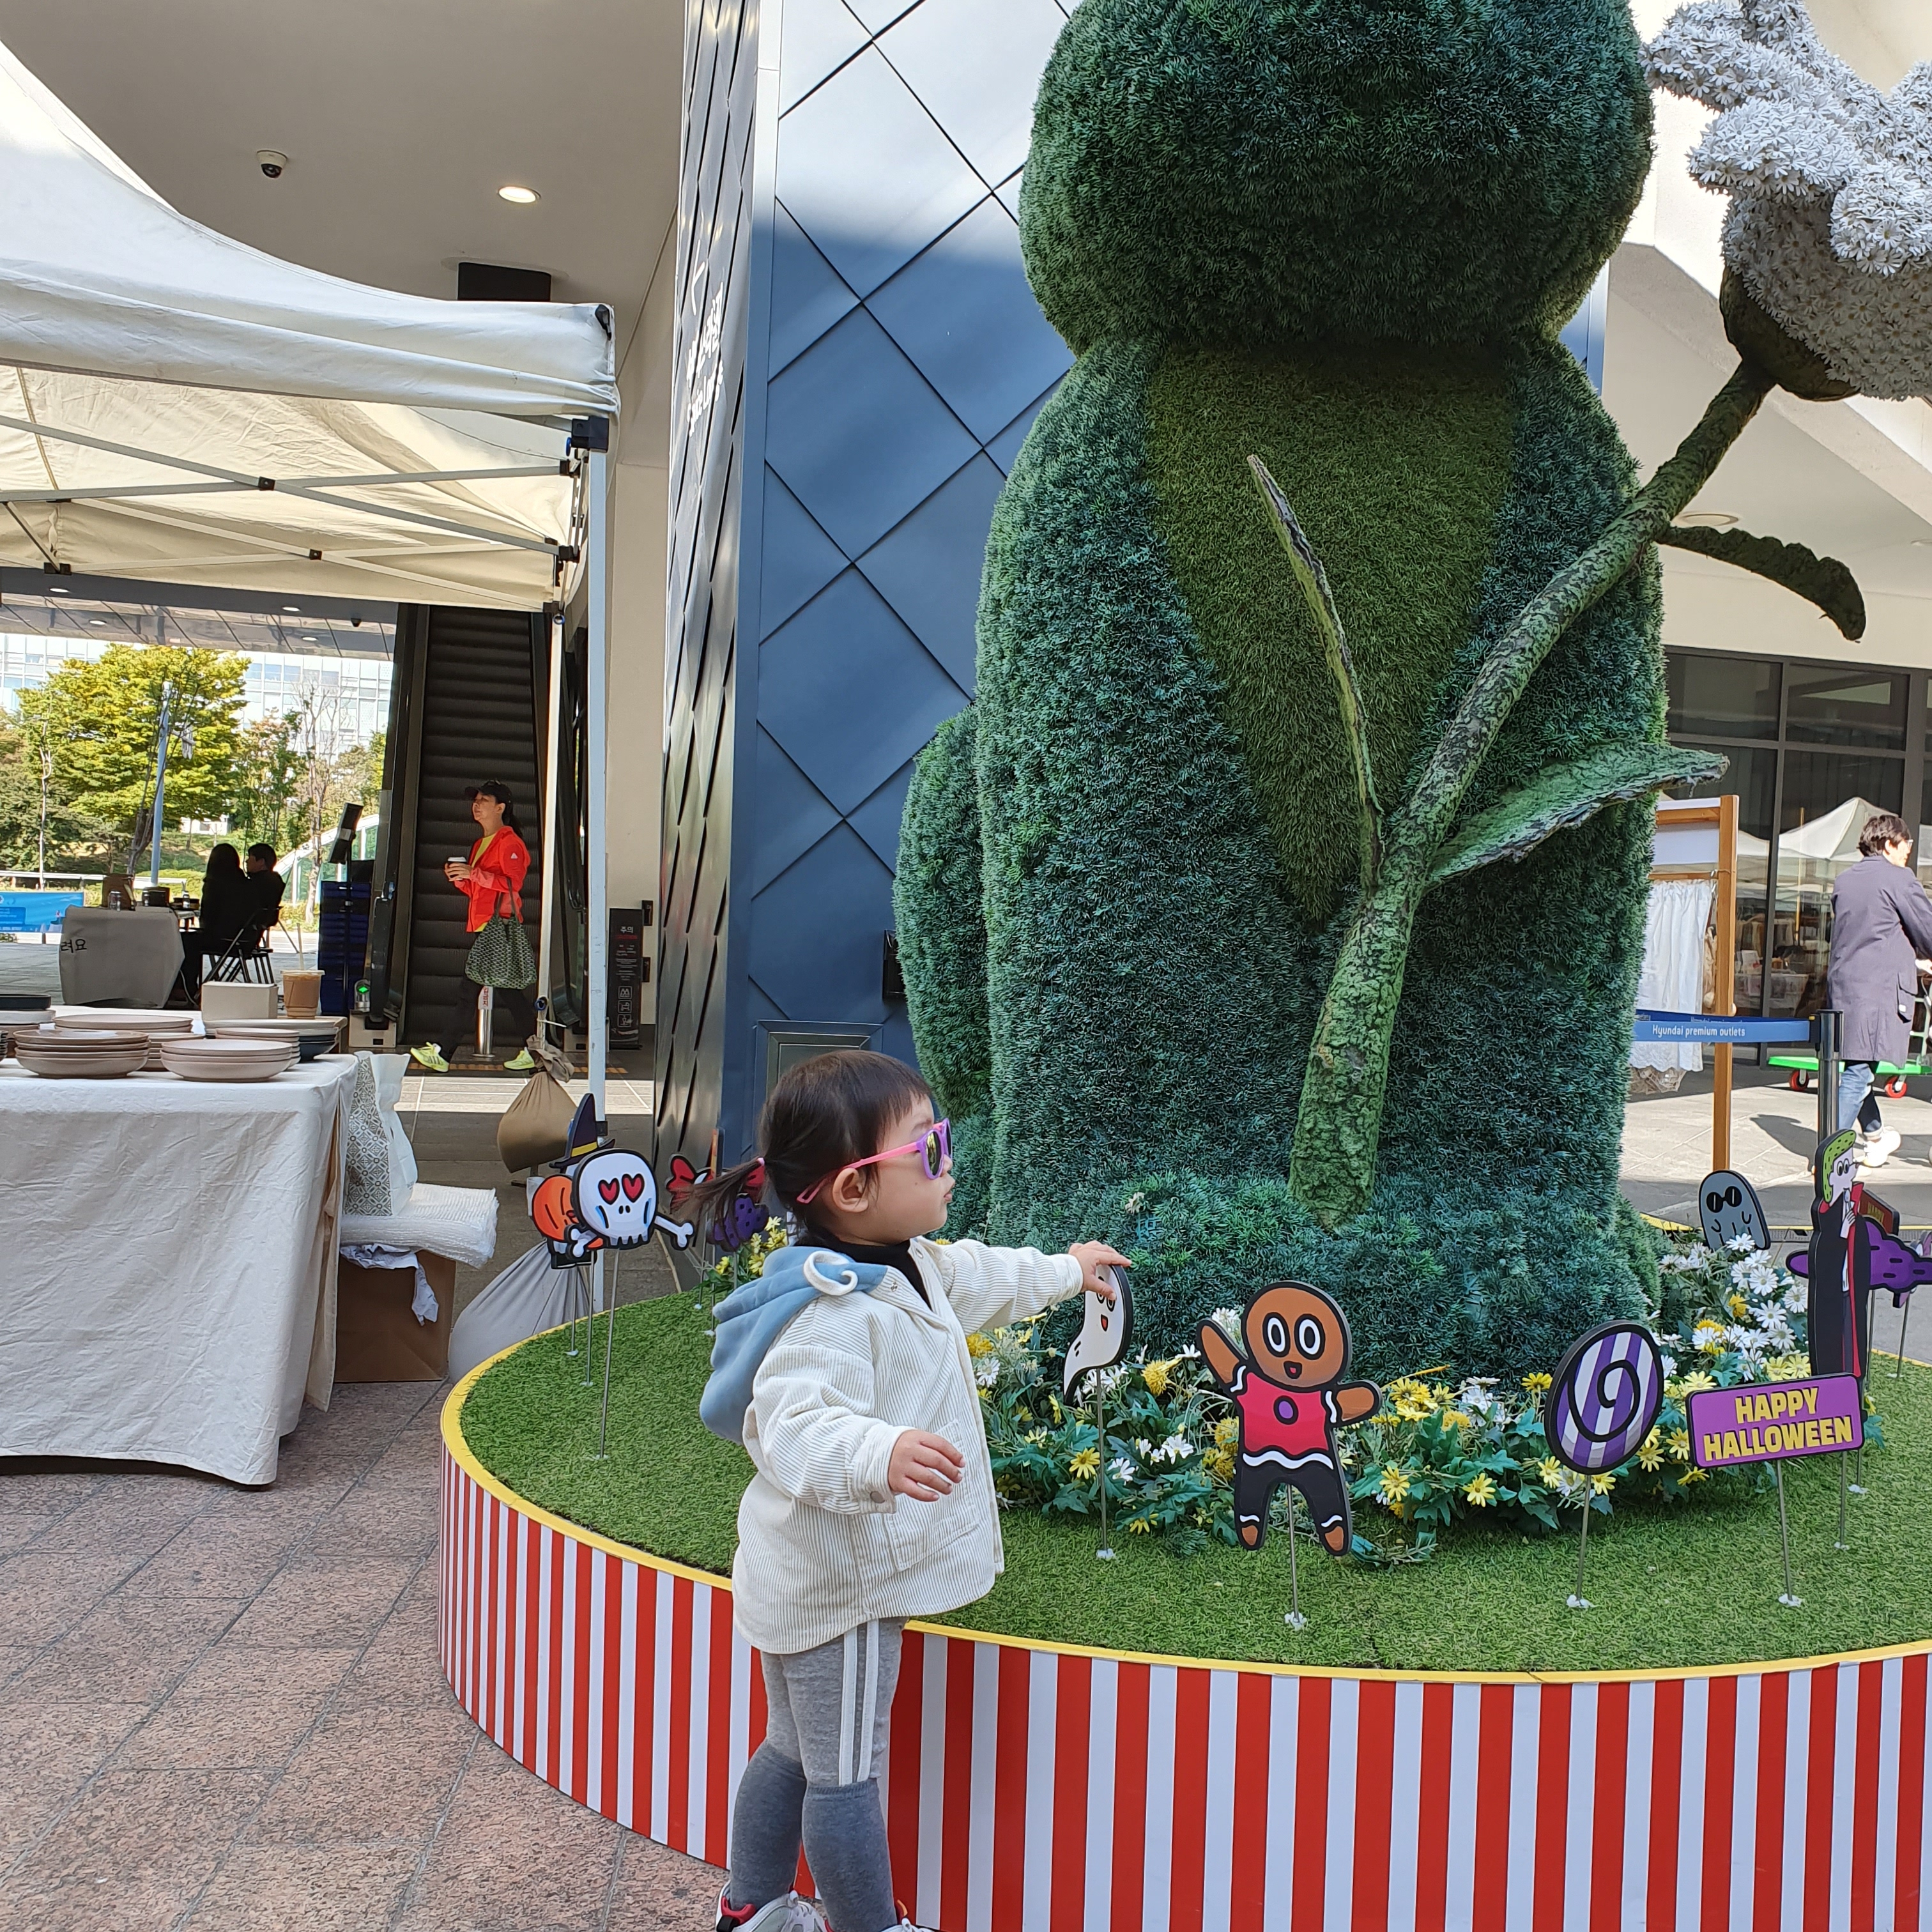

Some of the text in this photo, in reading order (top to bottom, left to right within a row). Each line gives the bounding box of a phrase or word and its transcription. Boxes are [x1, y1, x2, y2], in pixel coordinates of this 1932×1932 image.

[620, 926, 634, 934] 주의
[1652, 1024, 1745, 1038] Hyundai premium outlets
[1735, 1387, 1819, 1424] HAPPY
[1703, 1415, 1853, 1461] HALLOWEEN
